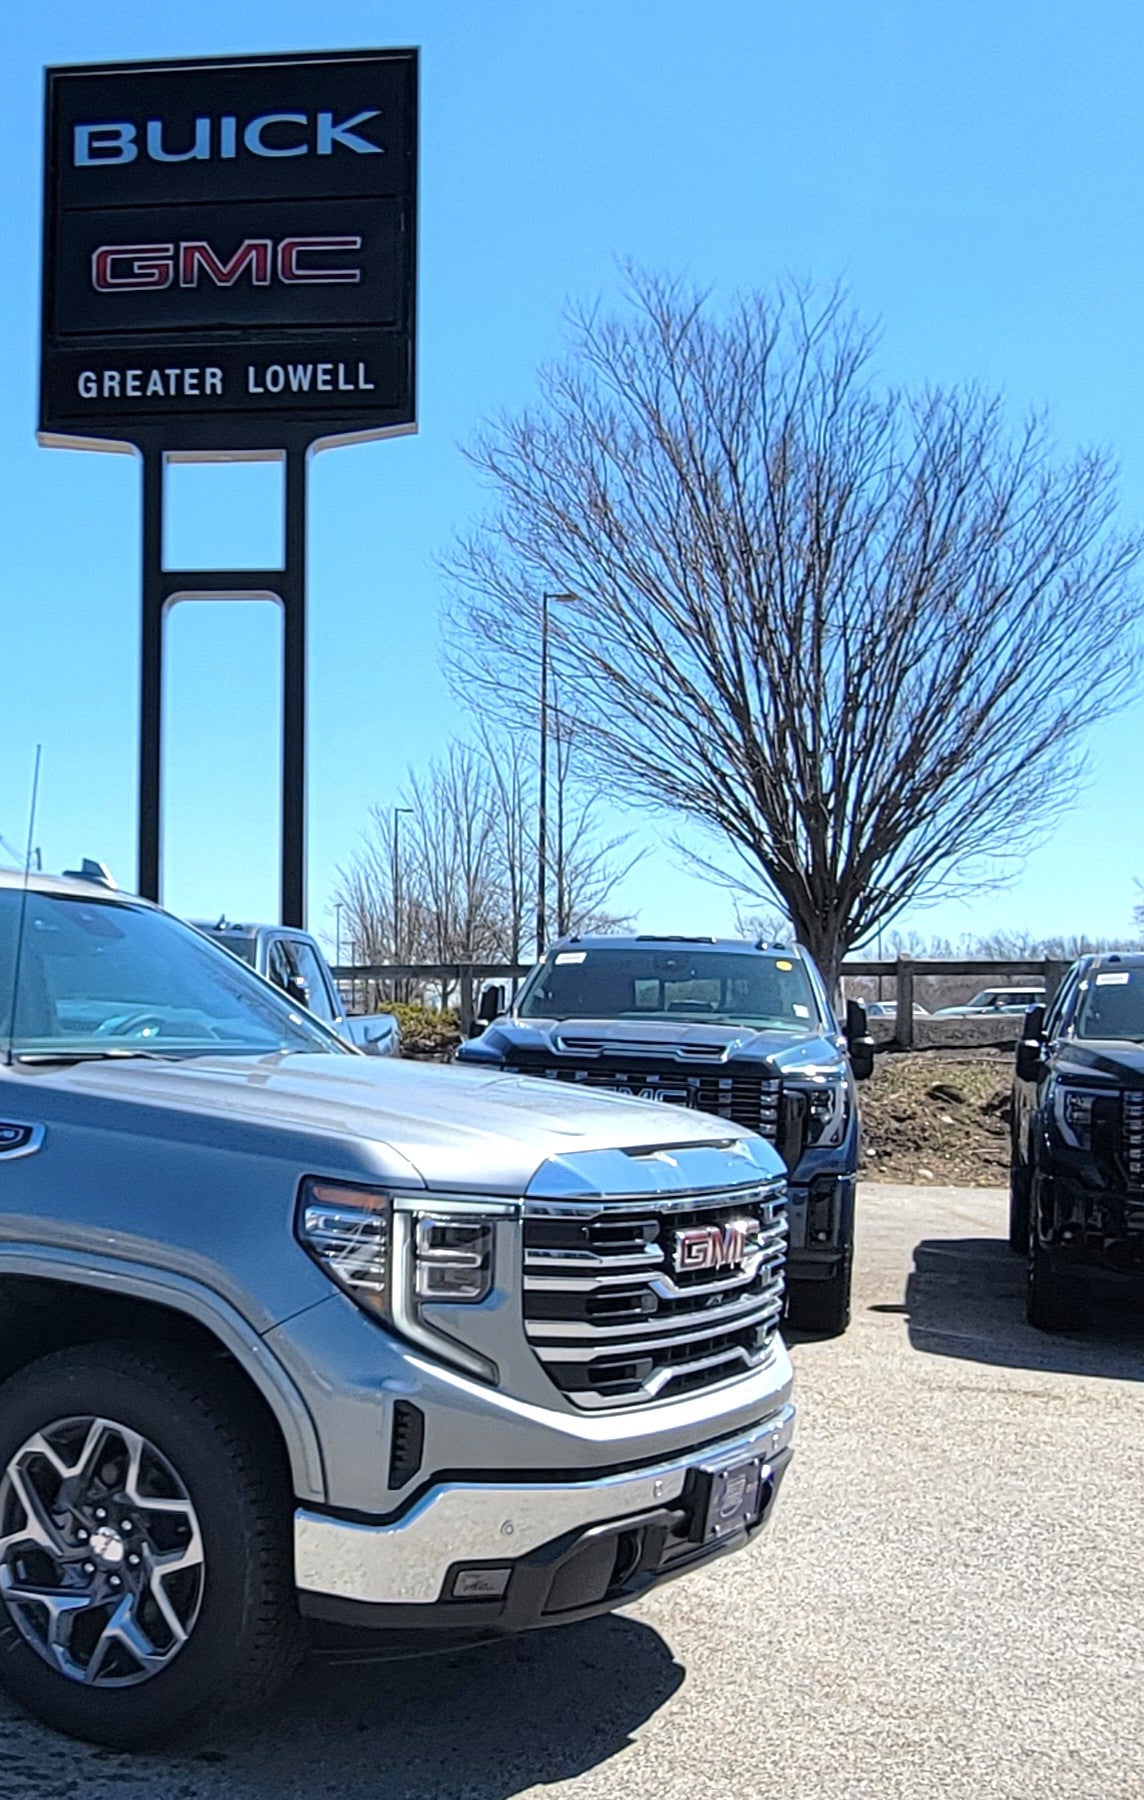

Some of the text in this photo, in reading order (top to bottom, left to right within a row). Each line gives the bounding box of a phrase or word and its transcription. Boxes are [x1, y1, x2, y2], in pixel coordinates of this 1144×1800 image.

[73, 110, 384, 167] BUICK
[92, 236, 362, 292] GMC
[77, 362, 375, 399] GREATER LOWELL
[675, 1217, 760, 1273] GMC
